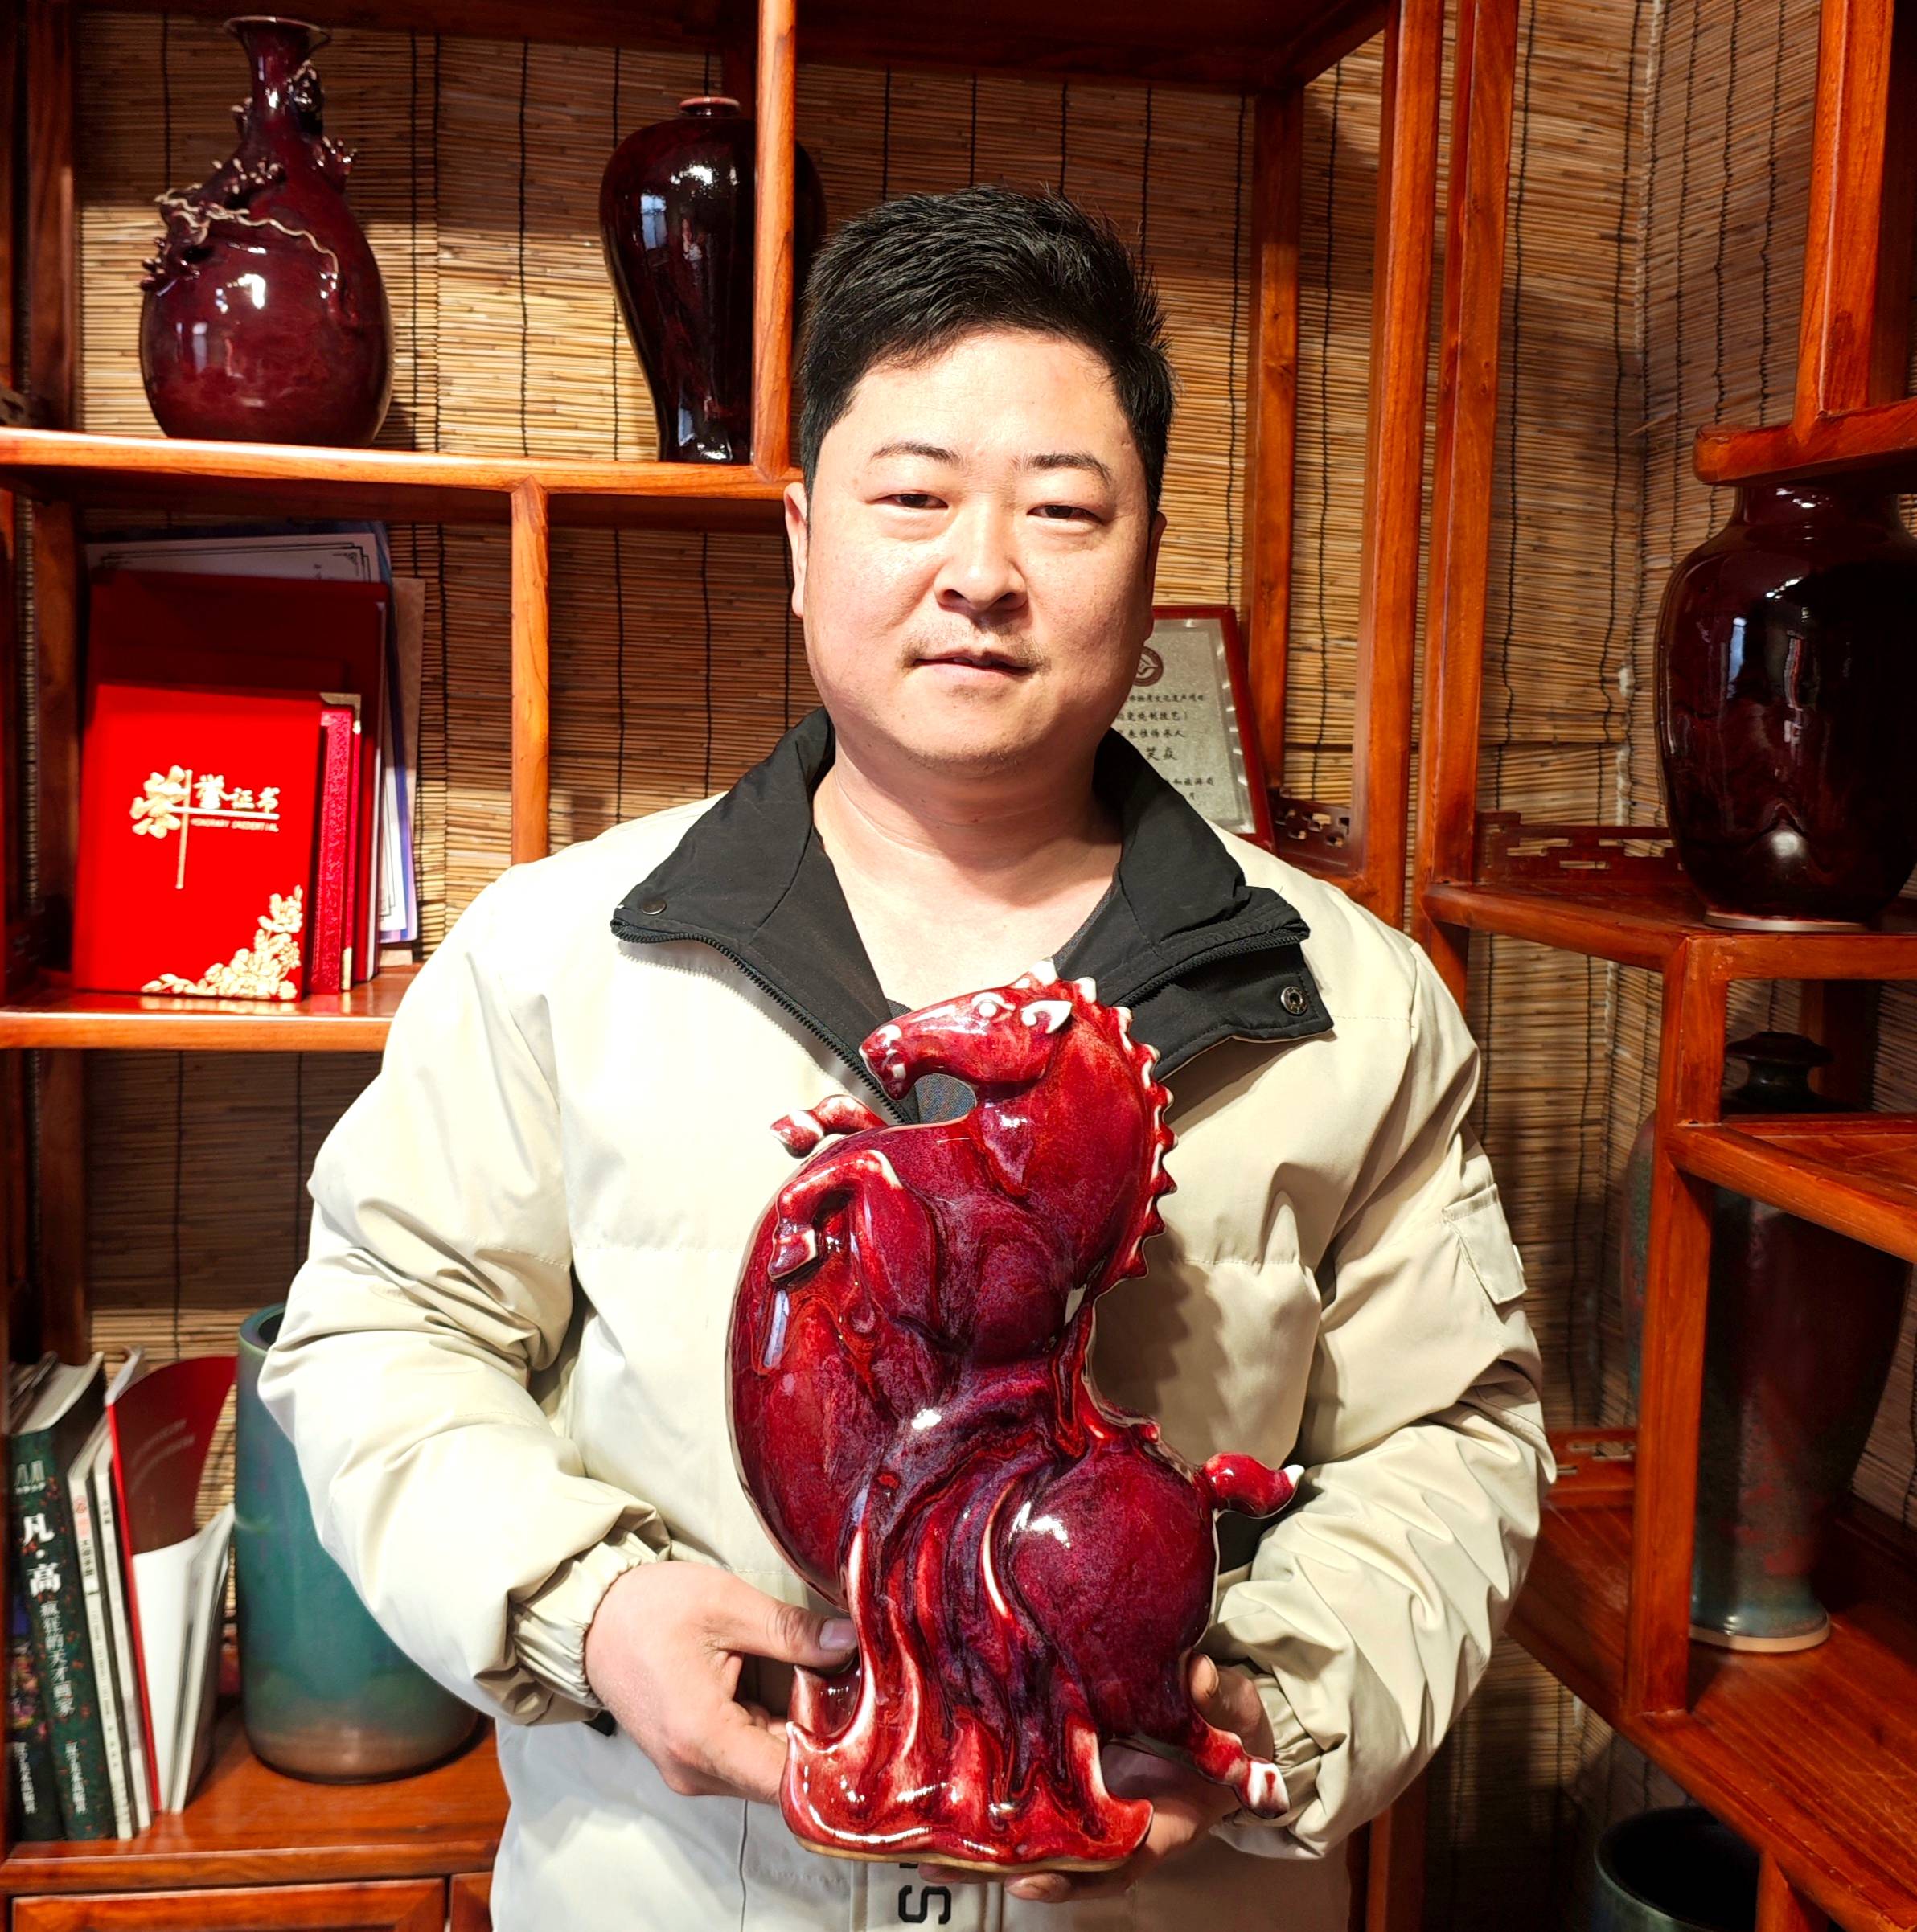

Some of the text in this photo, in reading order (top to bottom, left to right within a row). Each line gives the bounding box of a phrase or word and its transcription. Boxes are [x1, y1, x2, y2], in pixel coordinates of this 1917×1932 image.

[1118, 728, 1186, 739] 表性传承人
[1166, 777, 1215, 786] 和旅游局
